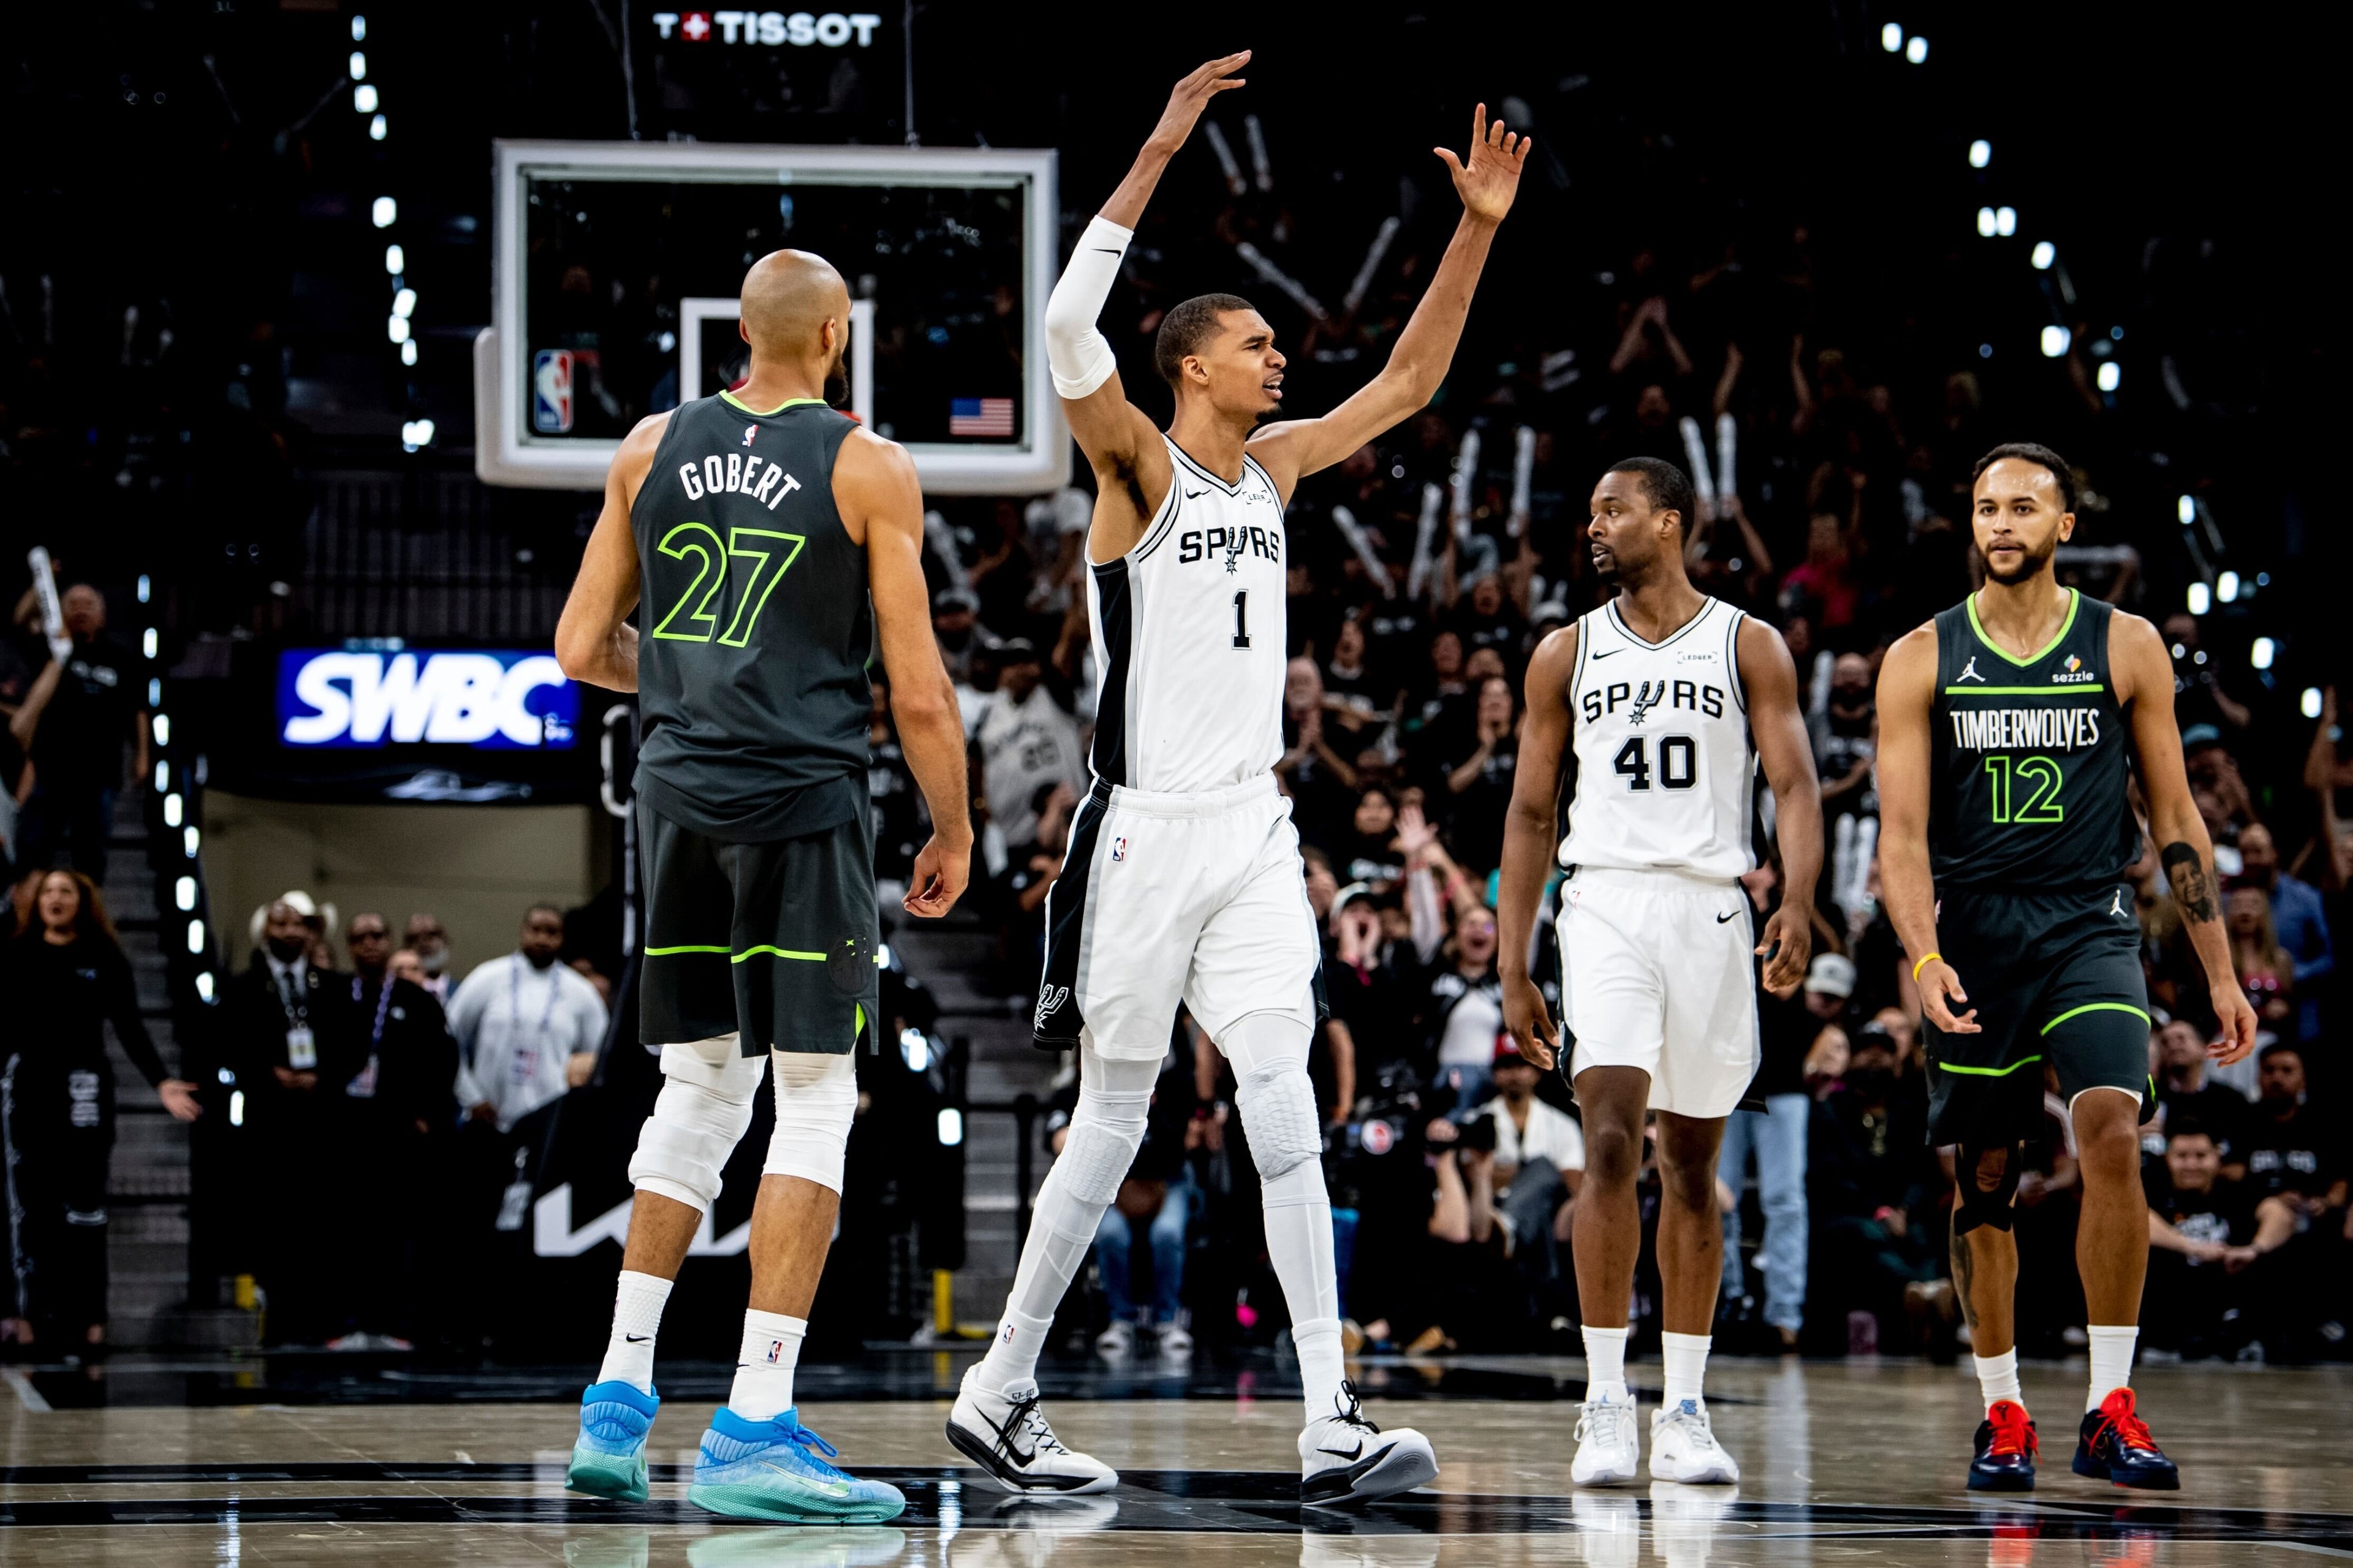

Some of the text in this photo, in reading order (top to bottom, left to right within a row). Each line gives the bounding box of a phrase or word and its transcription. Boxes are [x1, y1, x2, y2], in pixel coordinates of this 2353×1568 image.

[714, 10, 881, 48] TISSOT
[679, 453, 801, 510] GOBERT
[1179, 526, 1279, 576] SPURS
[652, 522, 806, 648] 27
[1231, 589, 1252, 651] 1
[283, 651, 567, 746] SWBC
[1583, 680, 1724, 727] SPURS
[2052, 670, 2094, 683] sezzle
[1949, 708, 2100, 754] TIMBERWOLVES
[1611, 733, 1699, 793] 40
[1985, 756, 2063, 823] 12
